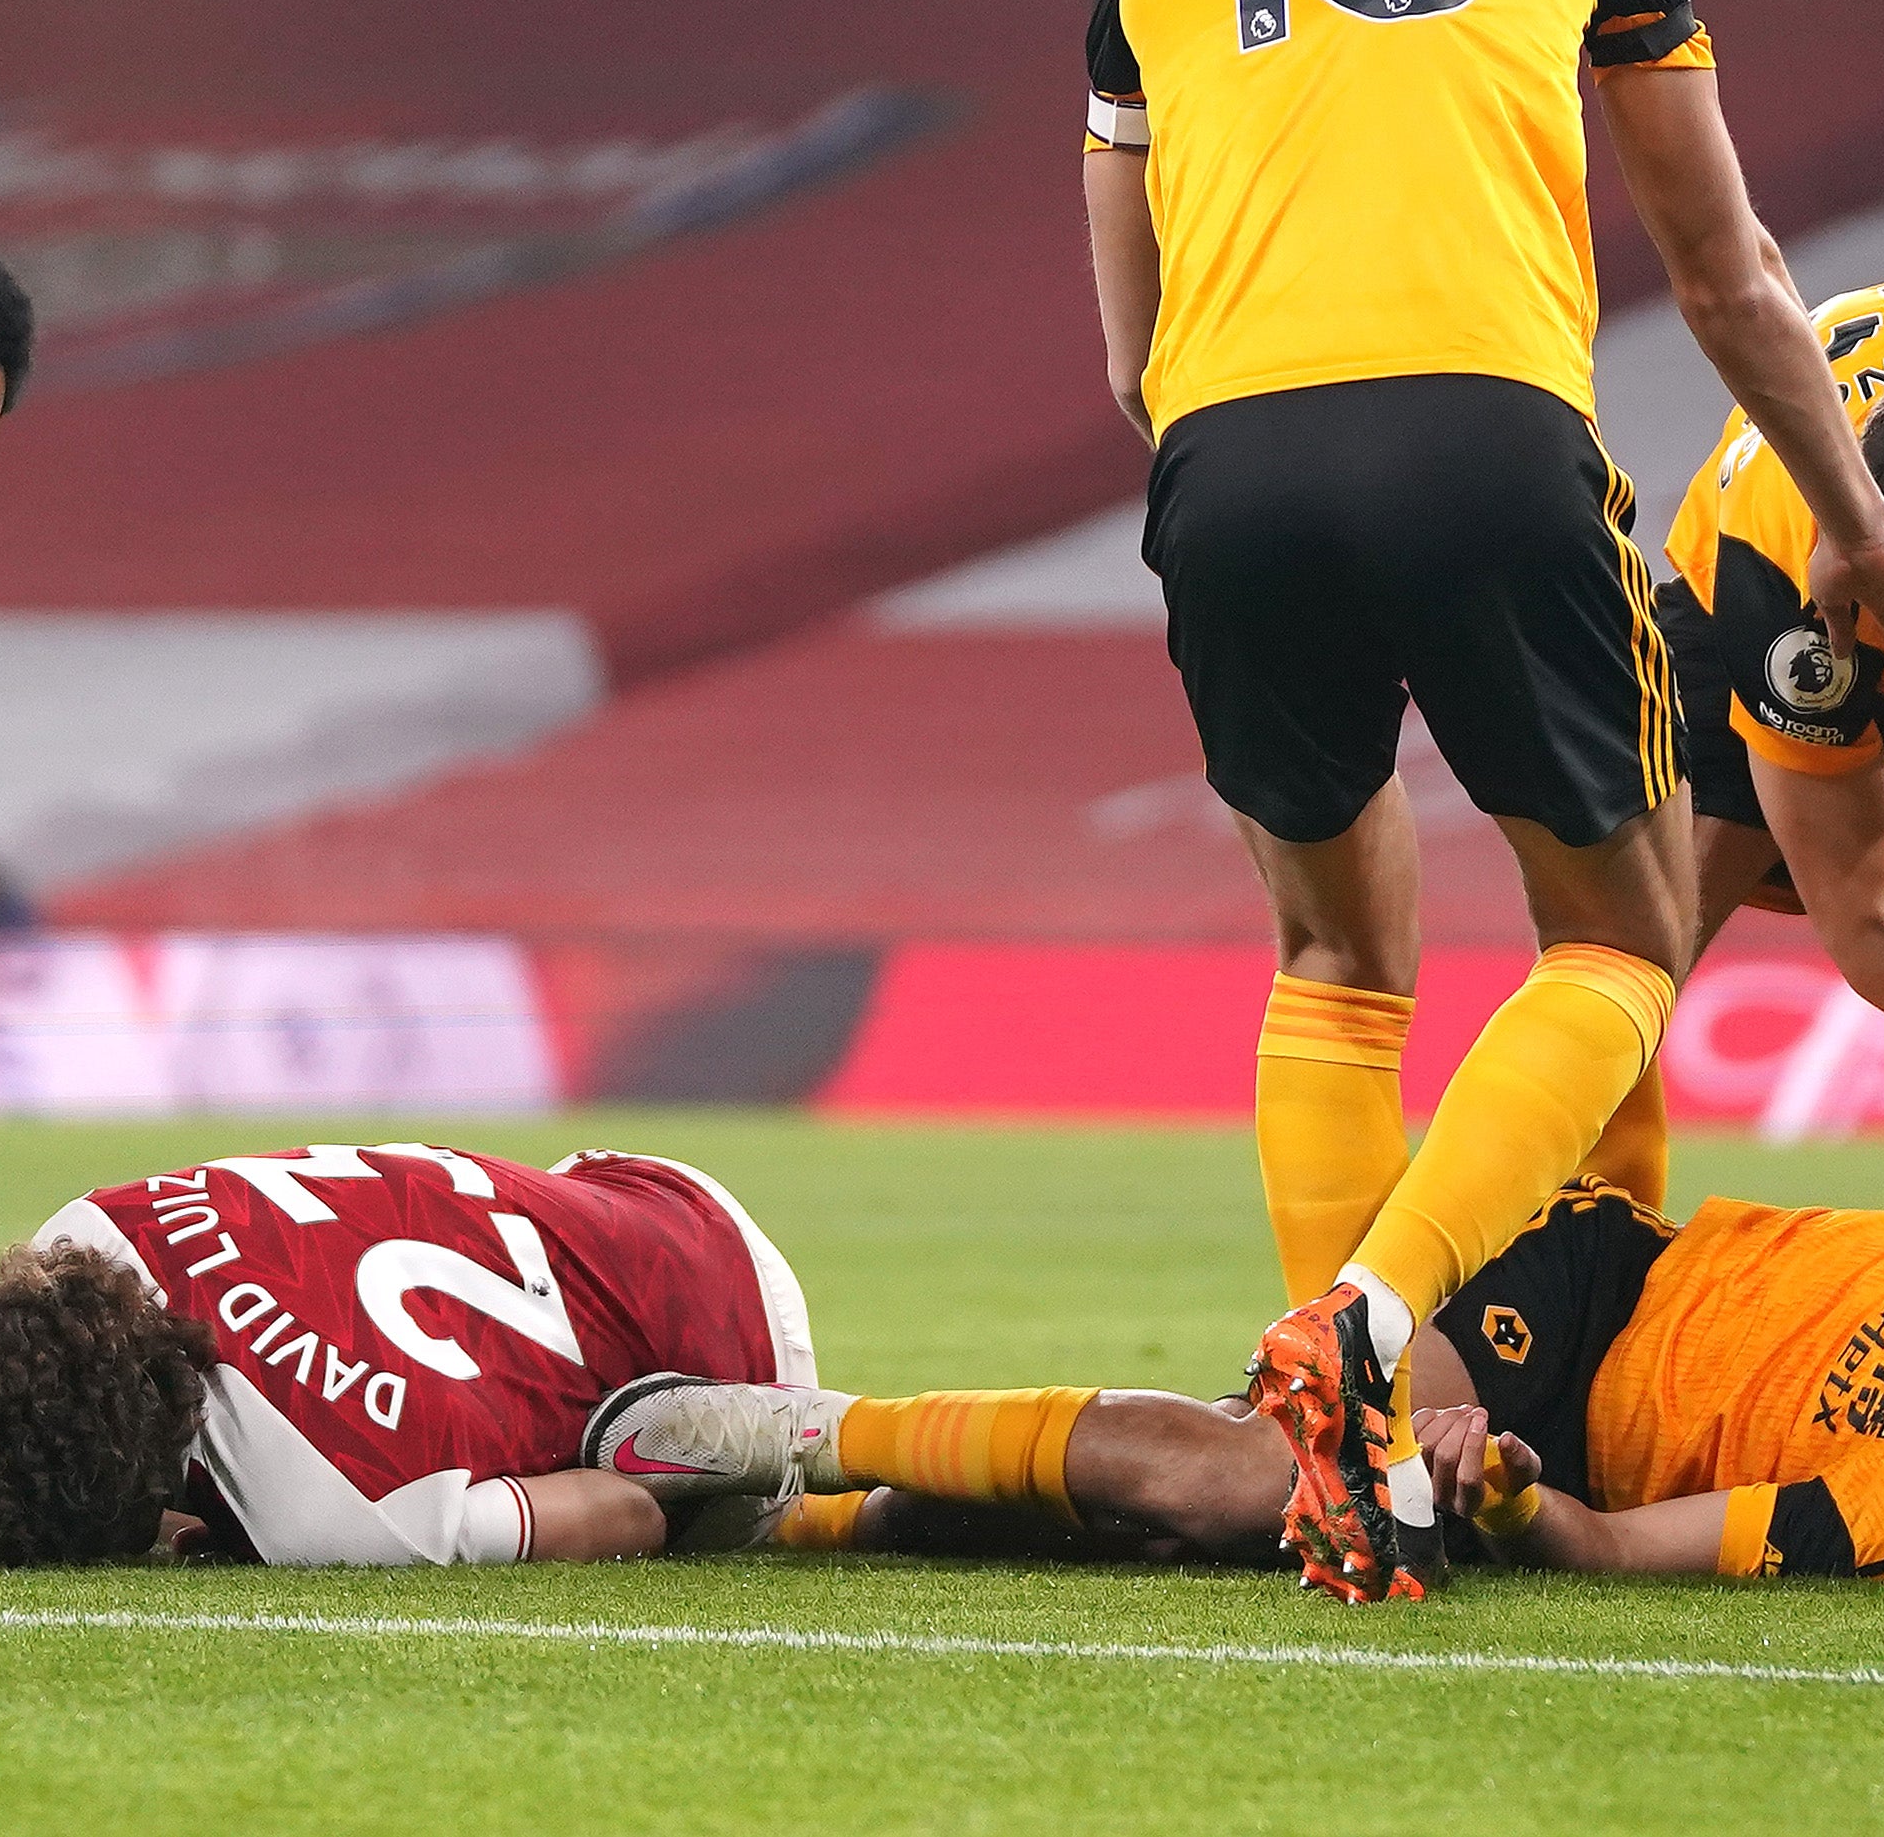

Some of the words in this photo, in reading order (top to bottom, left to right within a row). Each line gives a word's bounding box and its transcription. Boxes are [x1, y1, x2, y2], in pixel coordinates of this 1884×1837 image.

[1758, 700, 1784, 730] No
[1785, 718, 1839, 739] room
[146, 1168, 243, 1280] LUIZ
[217, 1280, 408, 1433] DAVID
